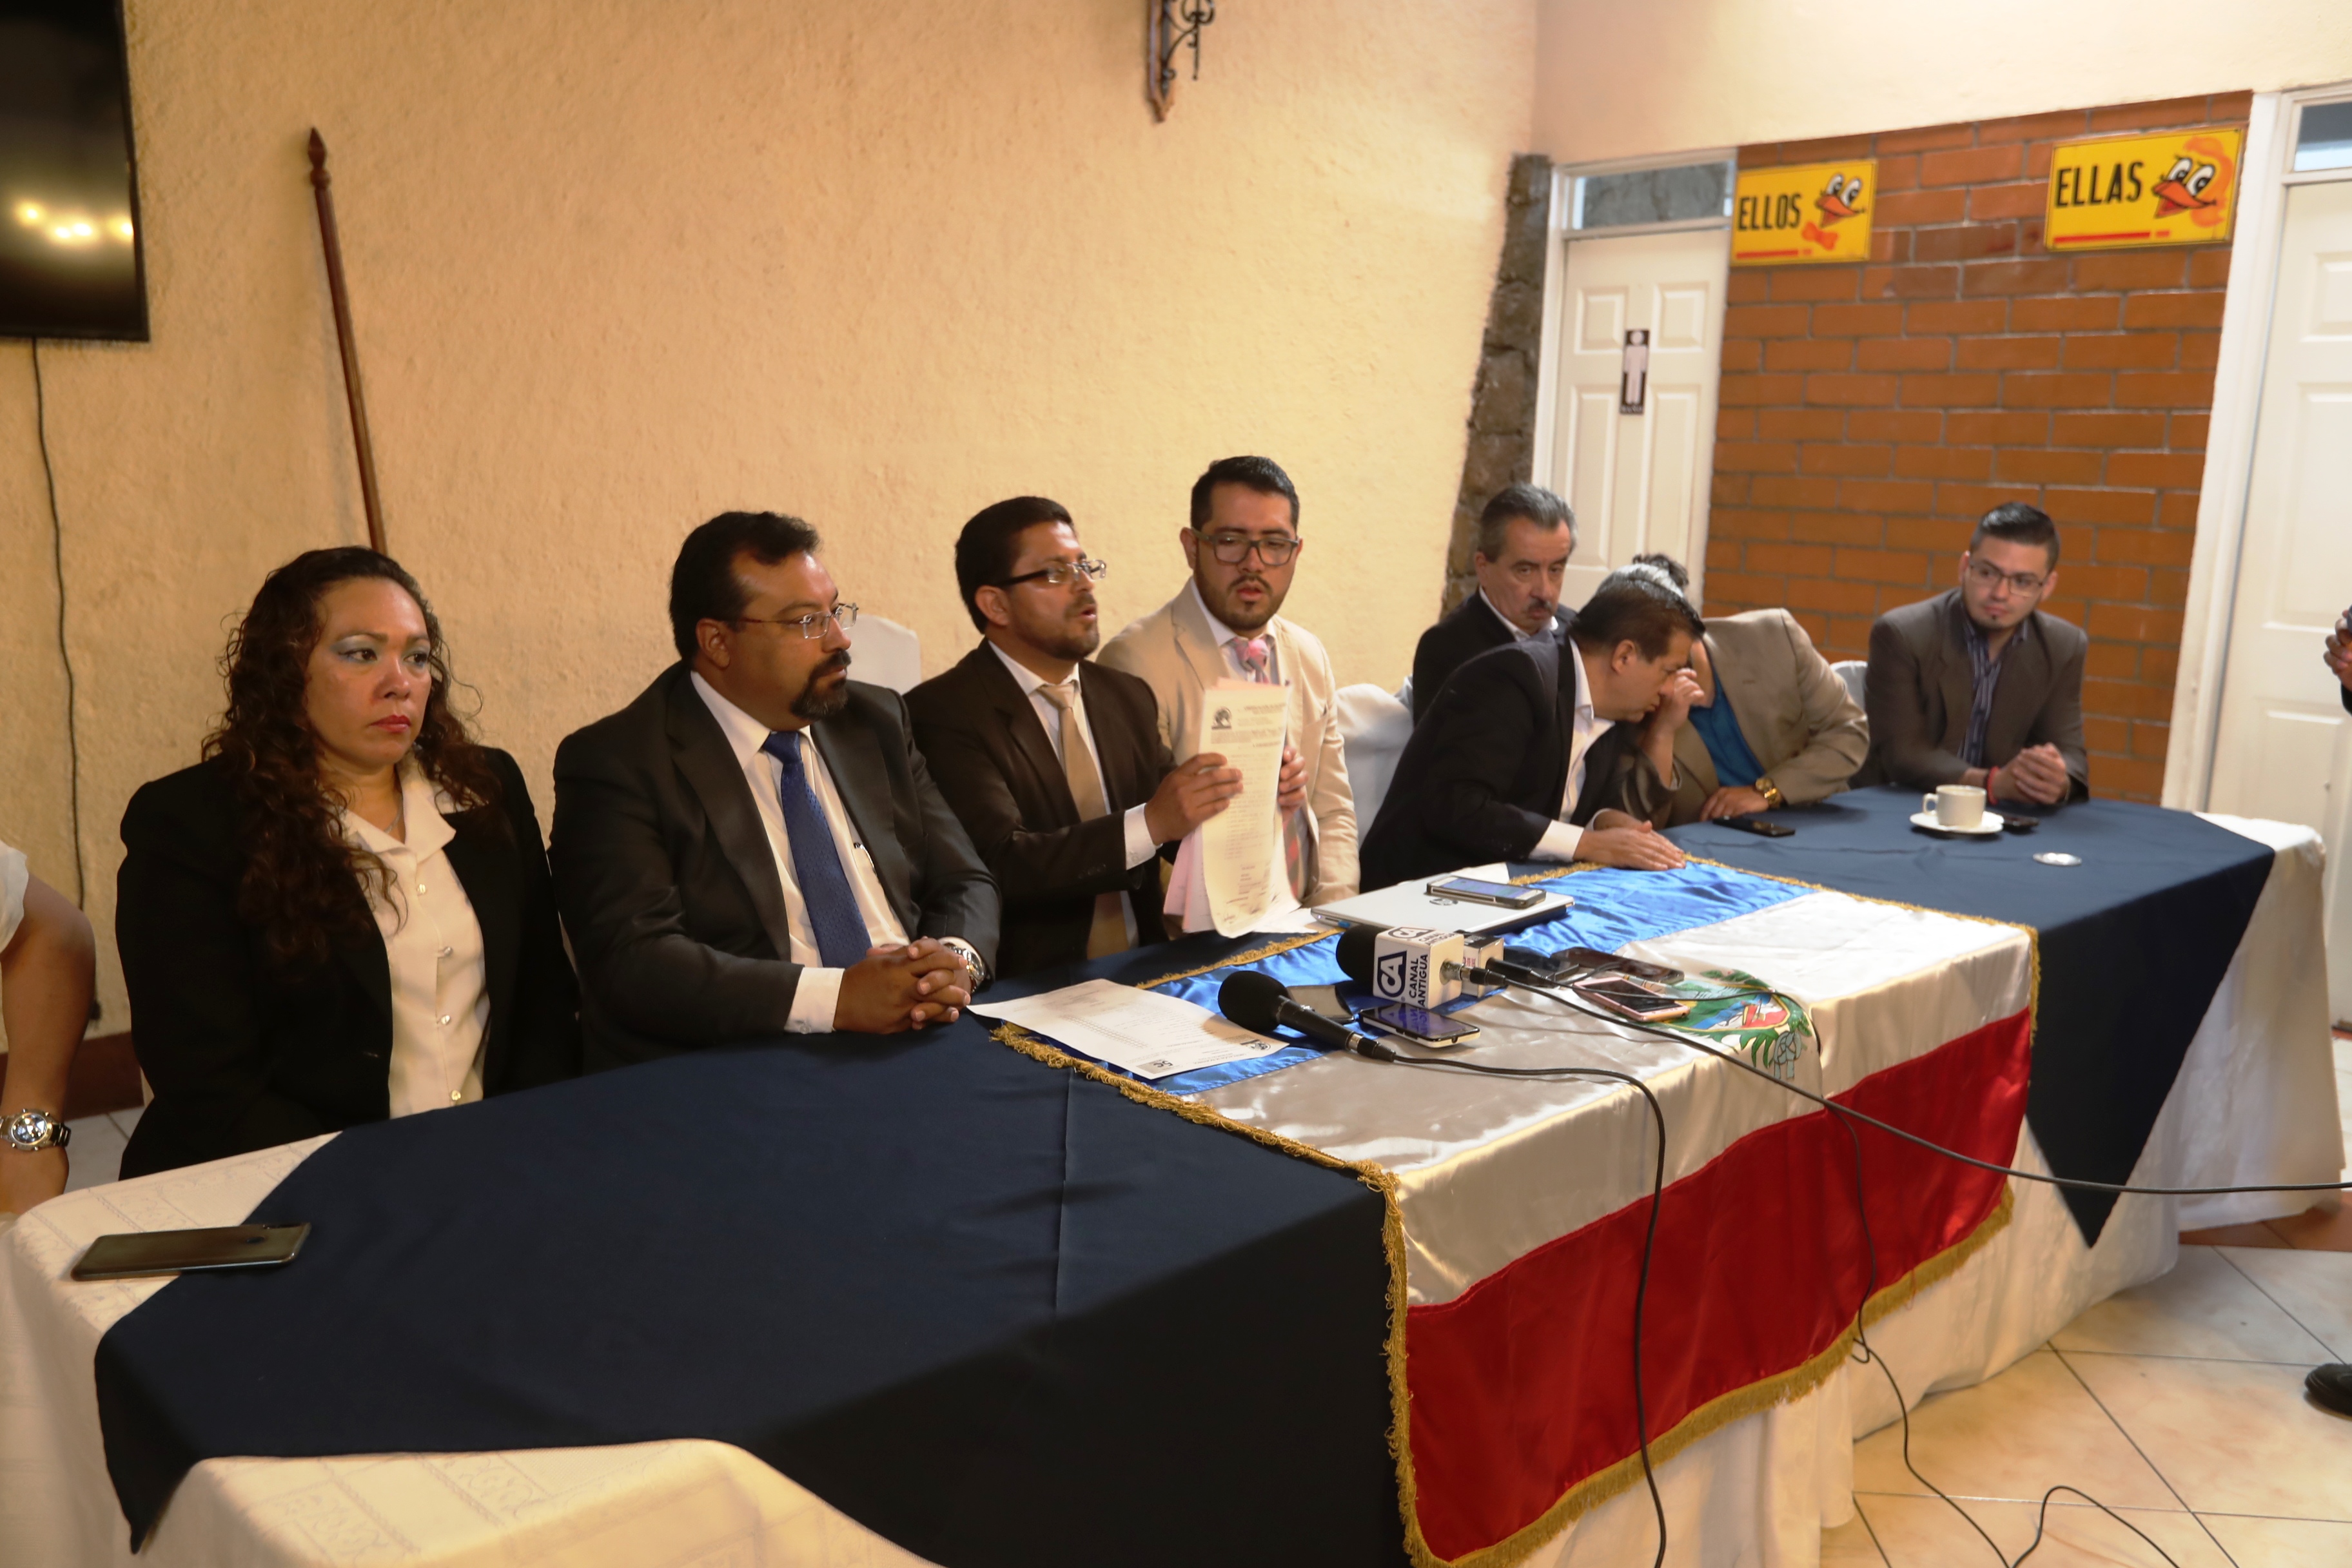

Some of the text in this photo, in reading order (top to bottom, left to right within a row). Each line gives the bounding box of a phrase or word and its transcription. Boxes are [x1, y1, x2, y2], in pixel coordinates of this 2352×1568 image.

[2055, 161, 2144, 208] ELLAS
[1738, 193, 1801, 231] ELLOS
[1409, 958, 1419, 999] CANAL
[1418, 954, 1429, 1008] ANTIGUA
